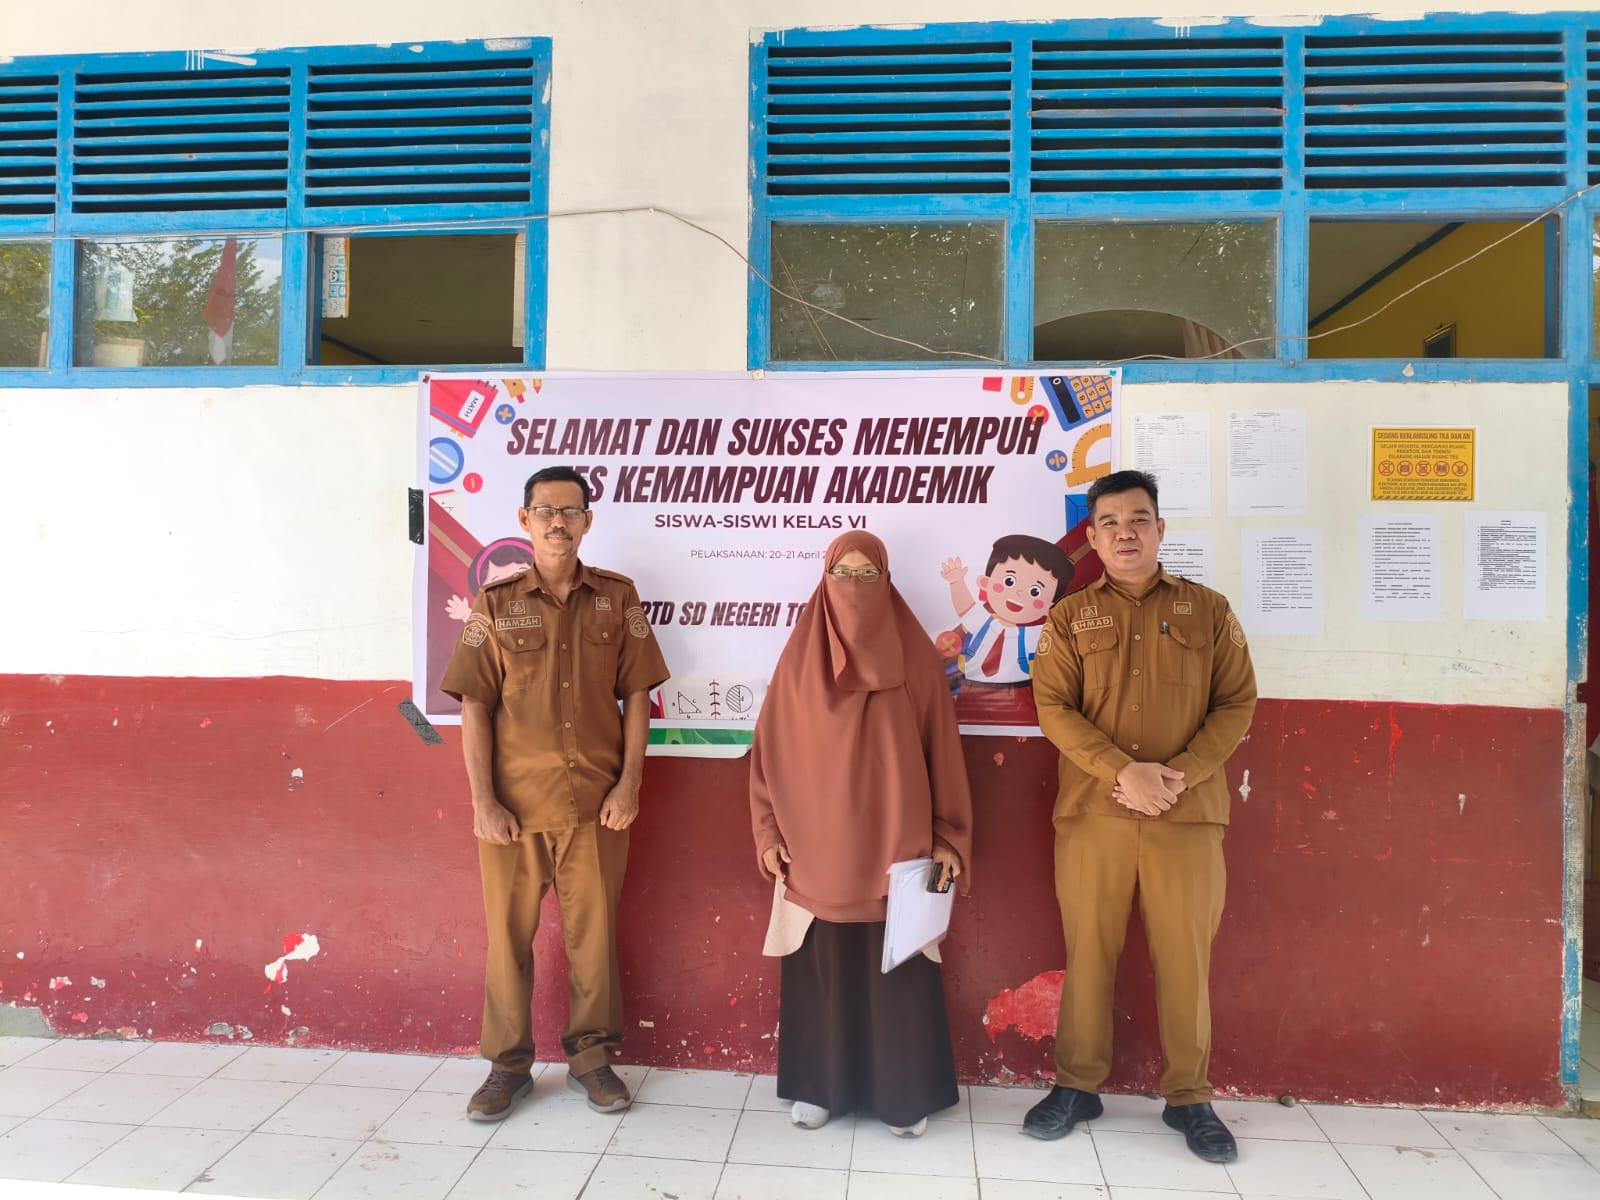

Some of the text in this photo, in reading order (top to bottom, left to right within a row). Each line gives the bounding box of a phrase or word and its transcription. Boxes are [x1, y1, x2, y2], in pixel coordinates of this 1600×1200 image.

[464, 397, 479, 418] MATH
[507, 417, 1044, 456] SELAMAT DAN SUKSES MENEMPUH
[1377, 431, 1399, 440] SEDANG
[1399, 431, 1438, 440] BERLANGSUNG
[613, 465, 820, 504] KEMAMPUAN
[823, 465, 995, 504] AKADEMIK
[654, 514, 867, 529] SISWA-SISWI KELAS VI
[690, 549, 767, 560] PELAKSANAAN:
[797, 550, 820, 561] April
[678, 601, 707, 626] SD
[710, 601, 782, 627] NEGERI
[498, 617, 539, 629] HAMZAH
[1073, 617, 1110, 632] AHMAD
